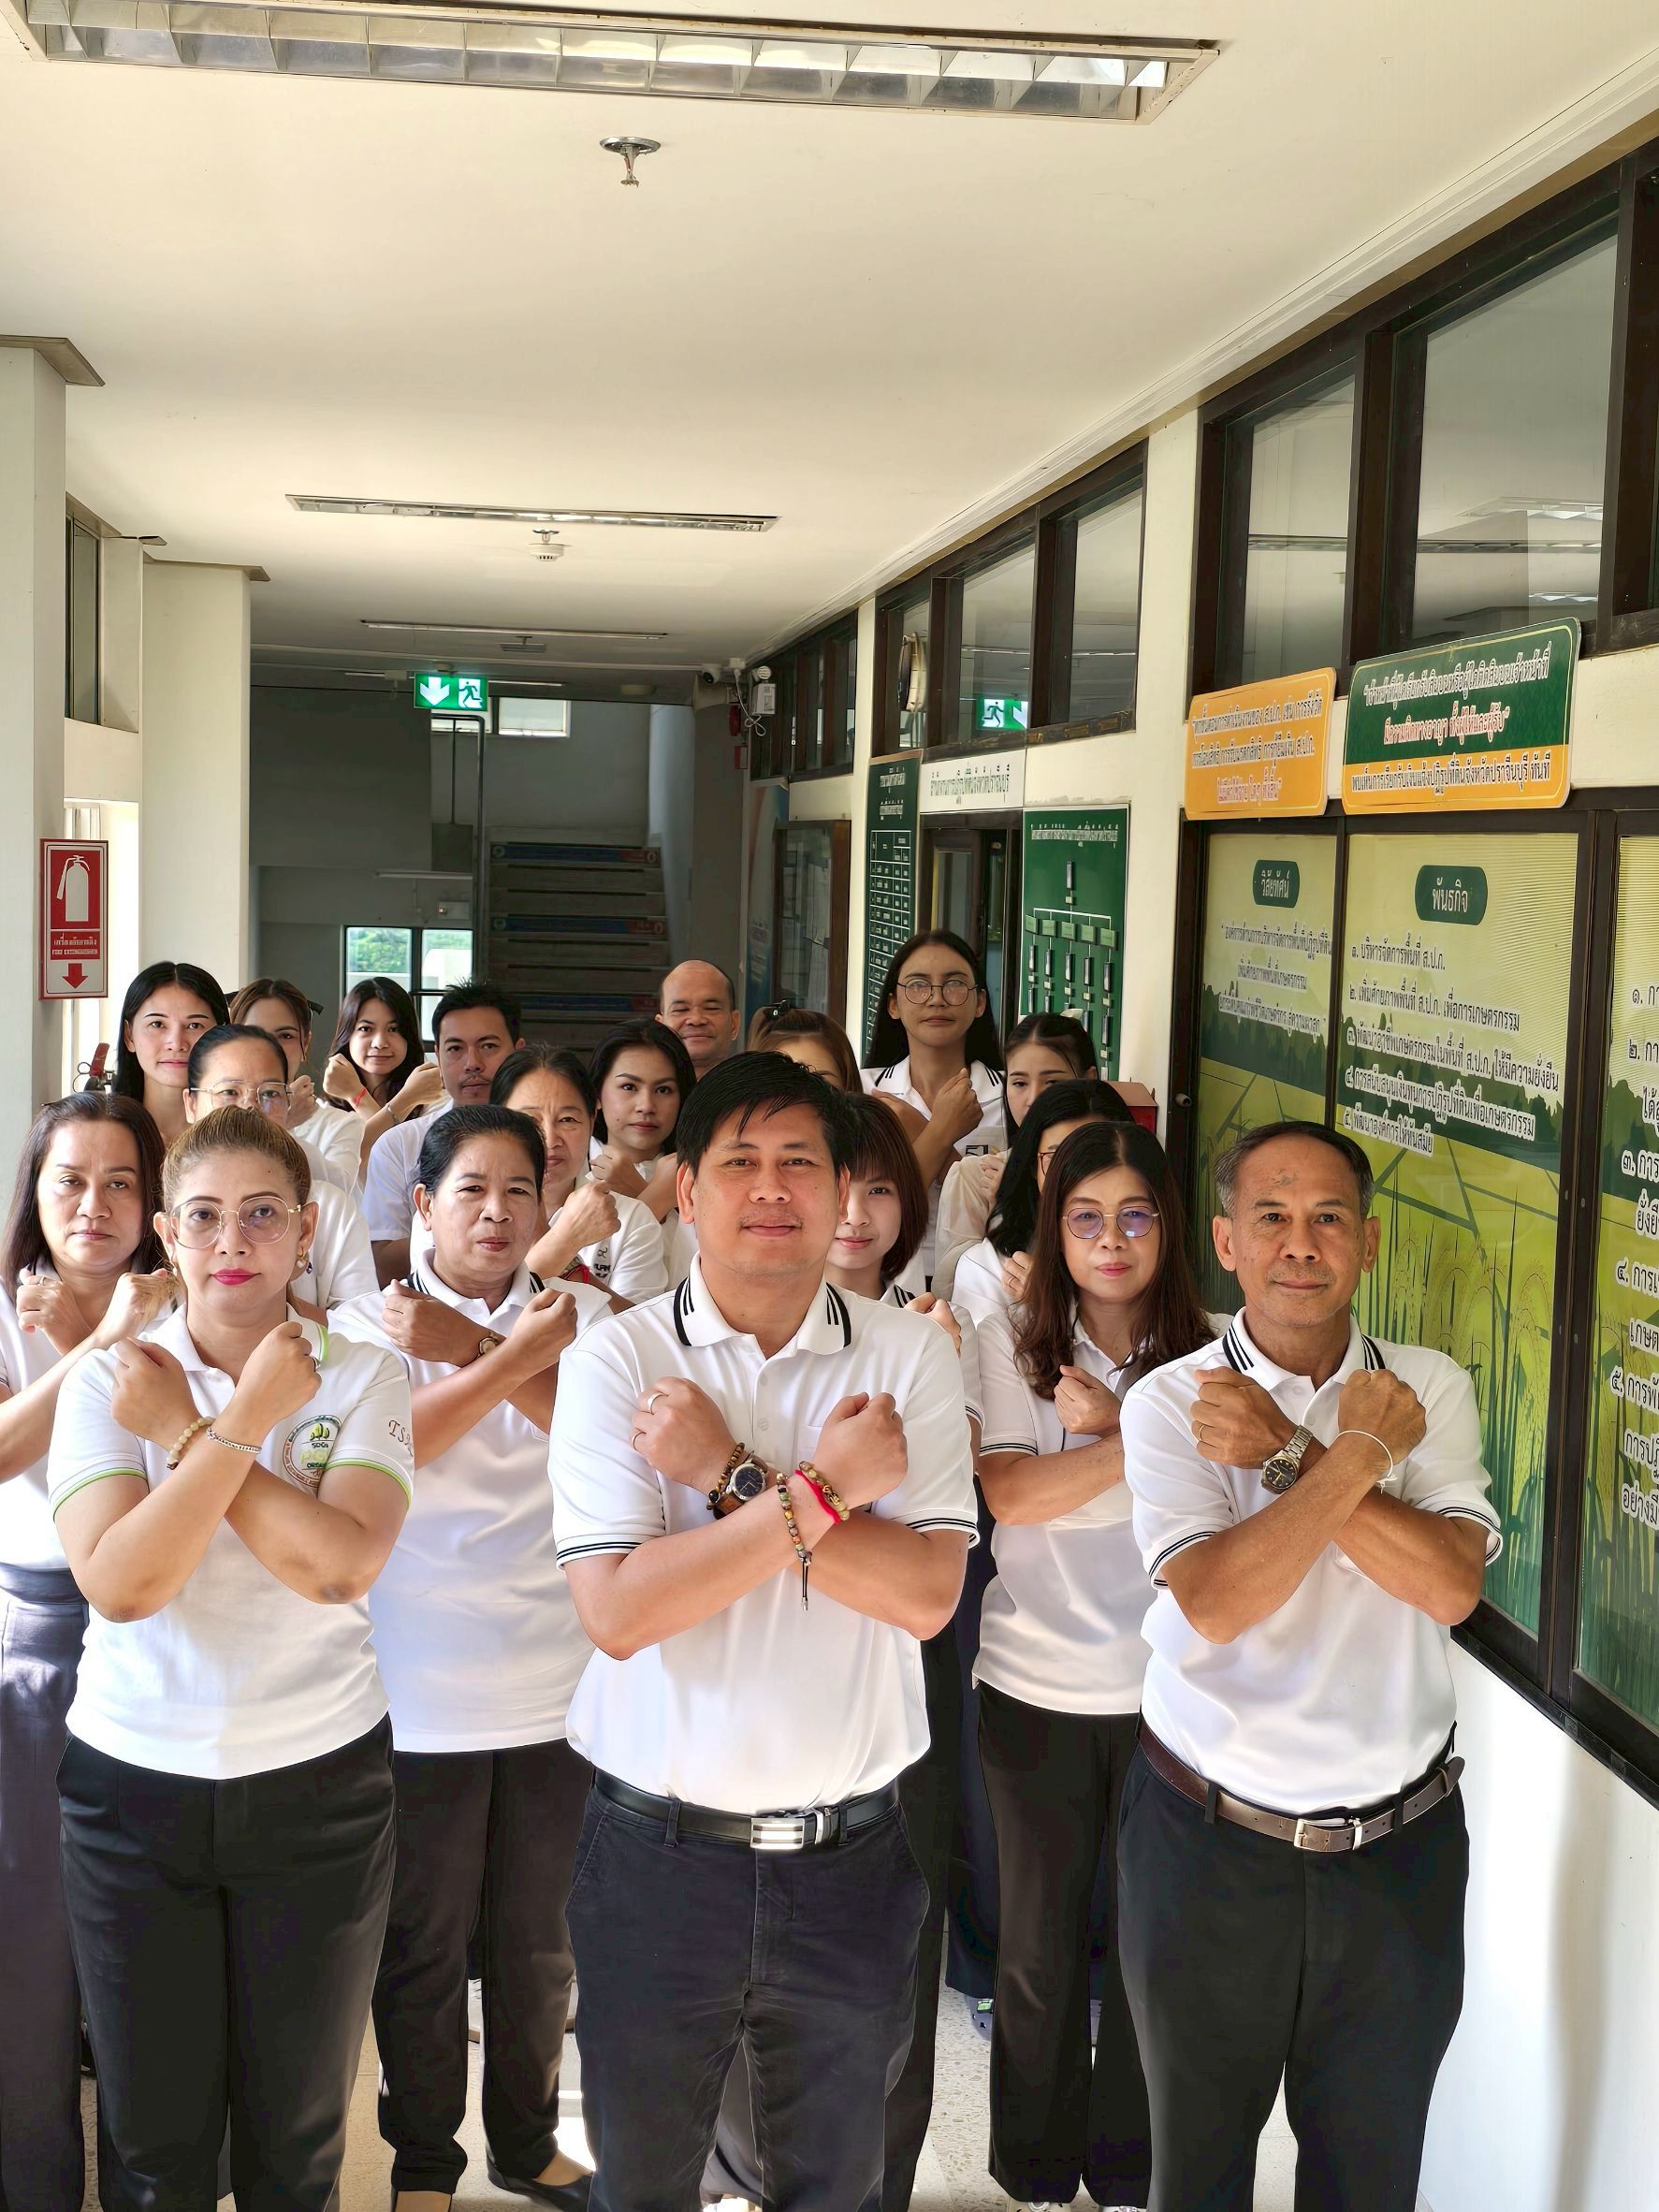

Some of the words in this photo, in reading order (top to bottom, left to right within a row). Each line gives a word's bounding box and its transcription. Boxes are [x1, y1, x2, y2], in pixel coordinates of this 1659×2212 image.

[1261, 870, 1289, 898] วิสัยทัศน์
[1433, 877, 1468, 913] พันธกิจ
[1423, 946, 1446, 970] ส.ป.ก.
[1419, 993, 1440, 1016] ส.ป.ก.
[1444, 987, 1520, 1031] เพื่อการเกษตรกรรม
[1467, 1049, 1492, 1075] ส.ป.ก.
[1494, 1049, 1559, 1092] ให้มีความยั่งยืน
